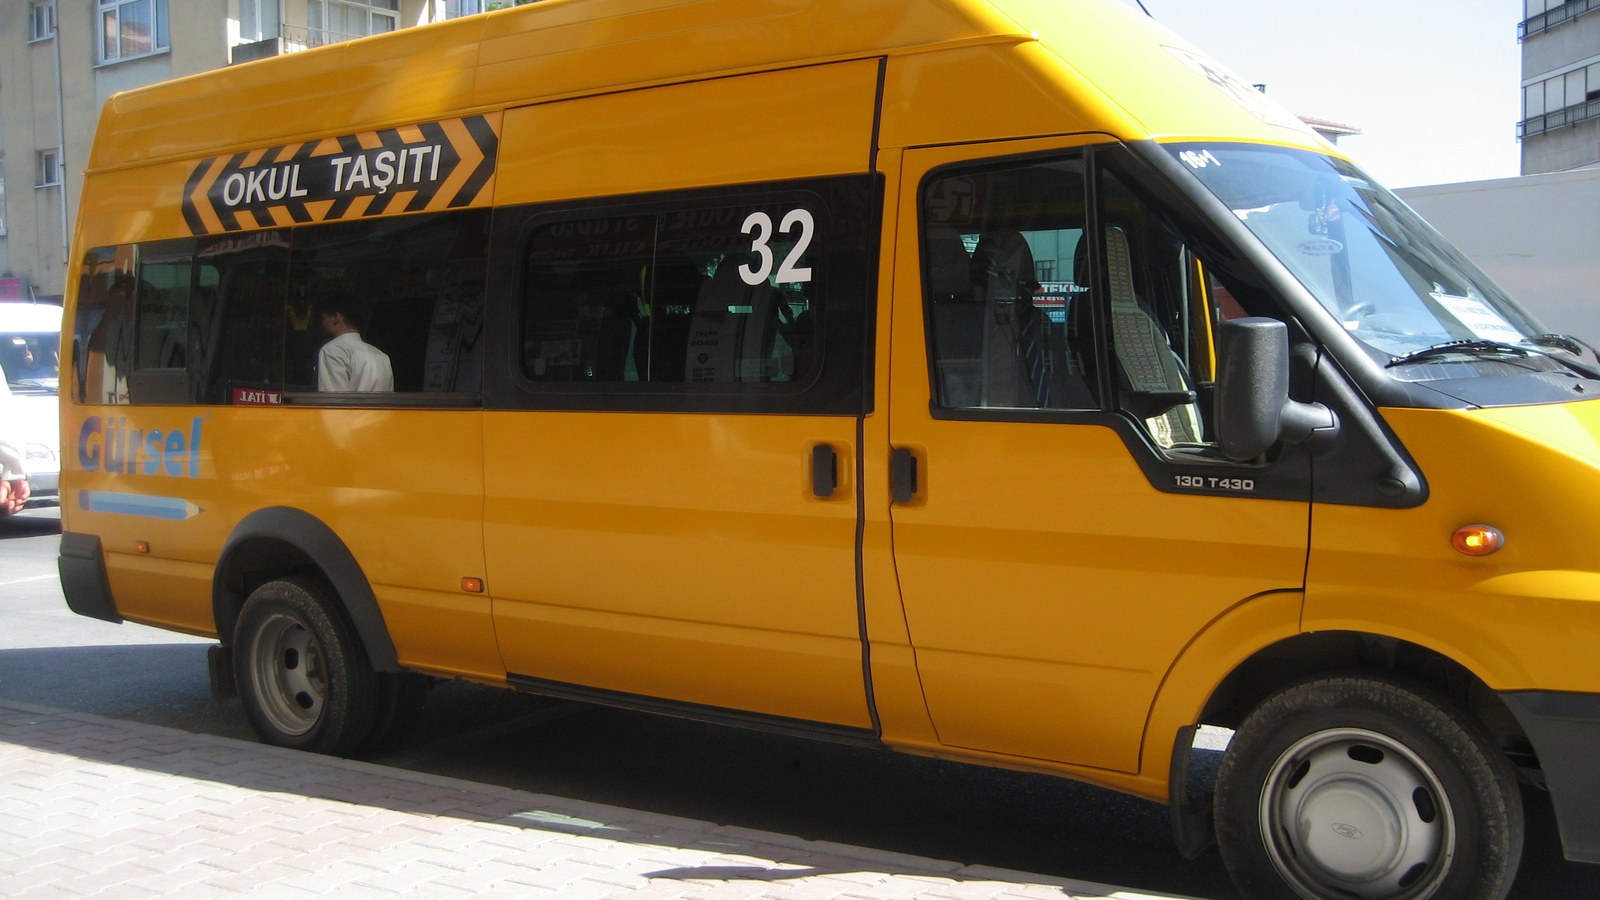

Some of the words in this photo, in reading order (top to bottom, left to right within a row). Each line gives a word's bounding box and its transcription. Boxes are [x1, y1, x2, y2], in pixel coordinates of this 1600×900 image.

[223, 164, 308, 207] OKUL
[331, 144, 442, 194] TAŞITI
[738, 208, 814, 286] 32
[78, 415, 203, 479] Gürsel
[1174, 475, 1204, 487] 130
[1207, 477, 1255, 491] T430
